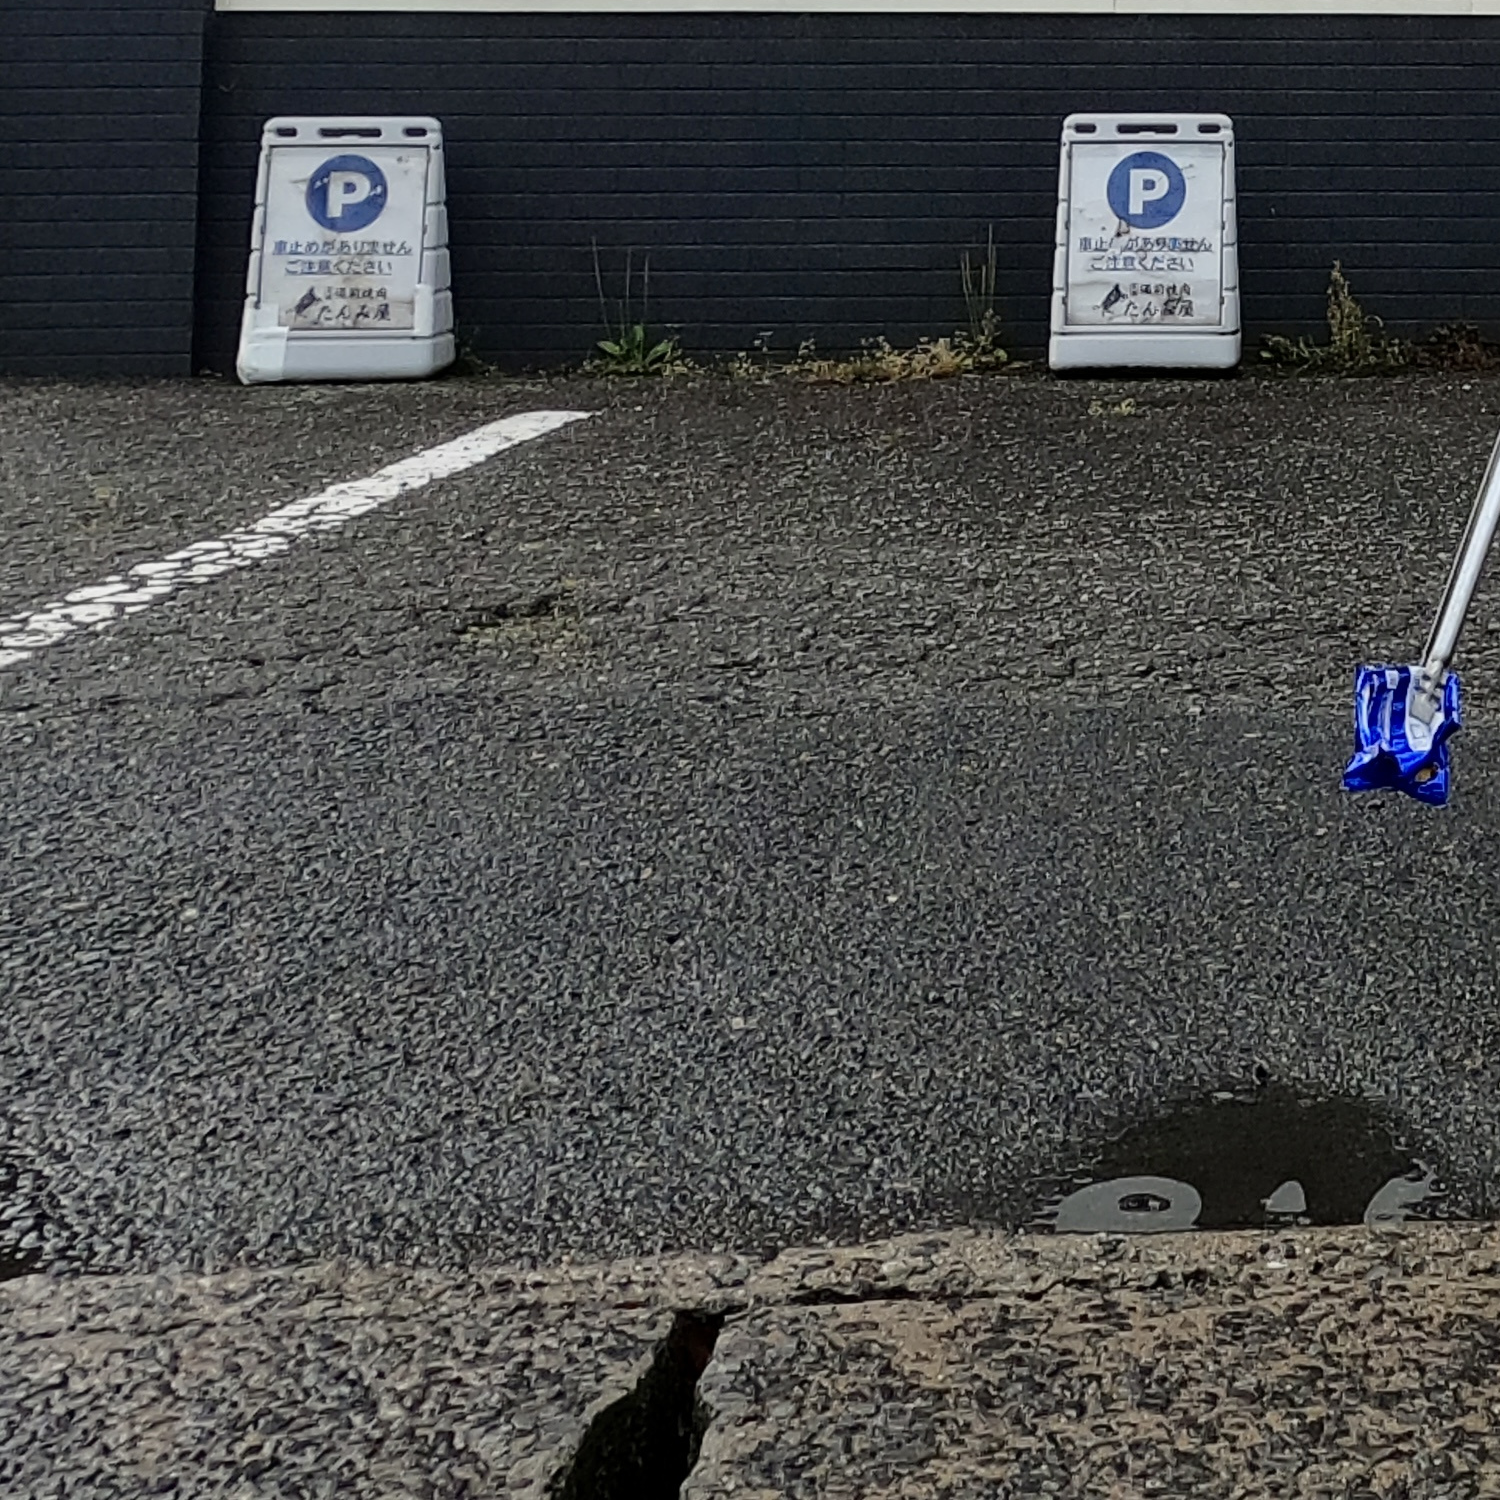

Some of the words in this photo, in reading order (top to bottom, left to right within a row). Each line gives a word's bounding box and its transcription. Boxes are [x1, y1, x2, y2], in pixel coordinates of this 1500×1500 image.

[326, 170, 372, 218] P
[1128, 168, 1170, 215] P
[285, 259, 393, 275] ご注意ください
[1091, 255, 1194, 271] ご注意ください
